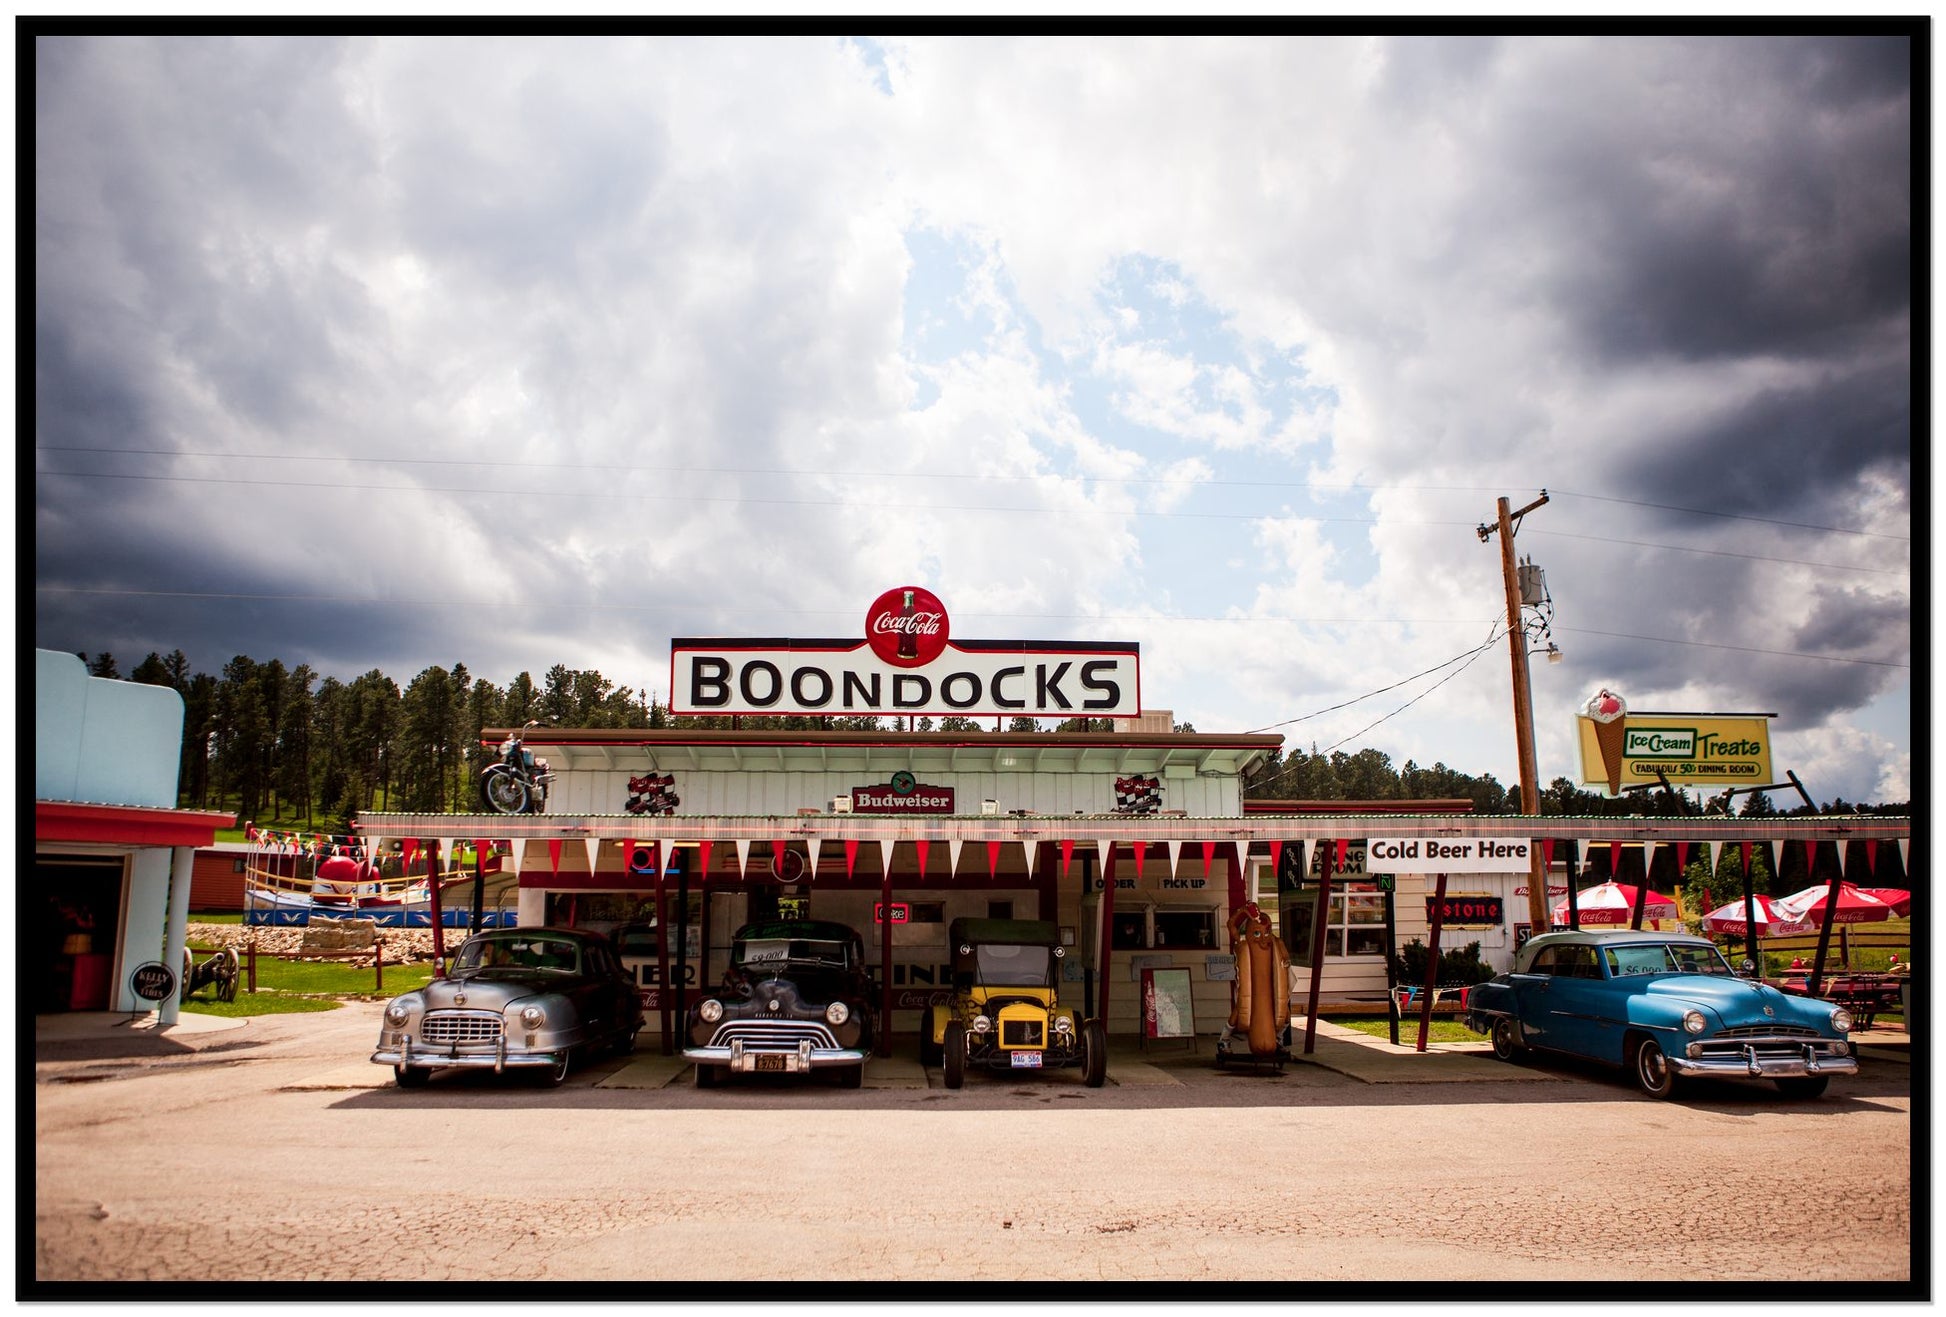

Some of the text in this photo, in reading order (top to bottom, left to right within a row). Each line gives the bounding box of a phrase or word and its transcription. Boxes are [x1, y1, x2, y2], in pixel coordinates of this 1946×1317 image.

[873, 611, 942, 635] Coca-Cola
[690, 656, 1121, 709] BOONDOCKS
[1698, 733, 1761, 759] Treats
[1698, 764, 1726, 773] DINING
[1729, 764, 1755, 773] ROOM
[857, 793, 950, 807] Budweiser
[1371, 841, 1528, 859] Cold Beer Here
[1163, 879, 1206, 889] PICK UP
